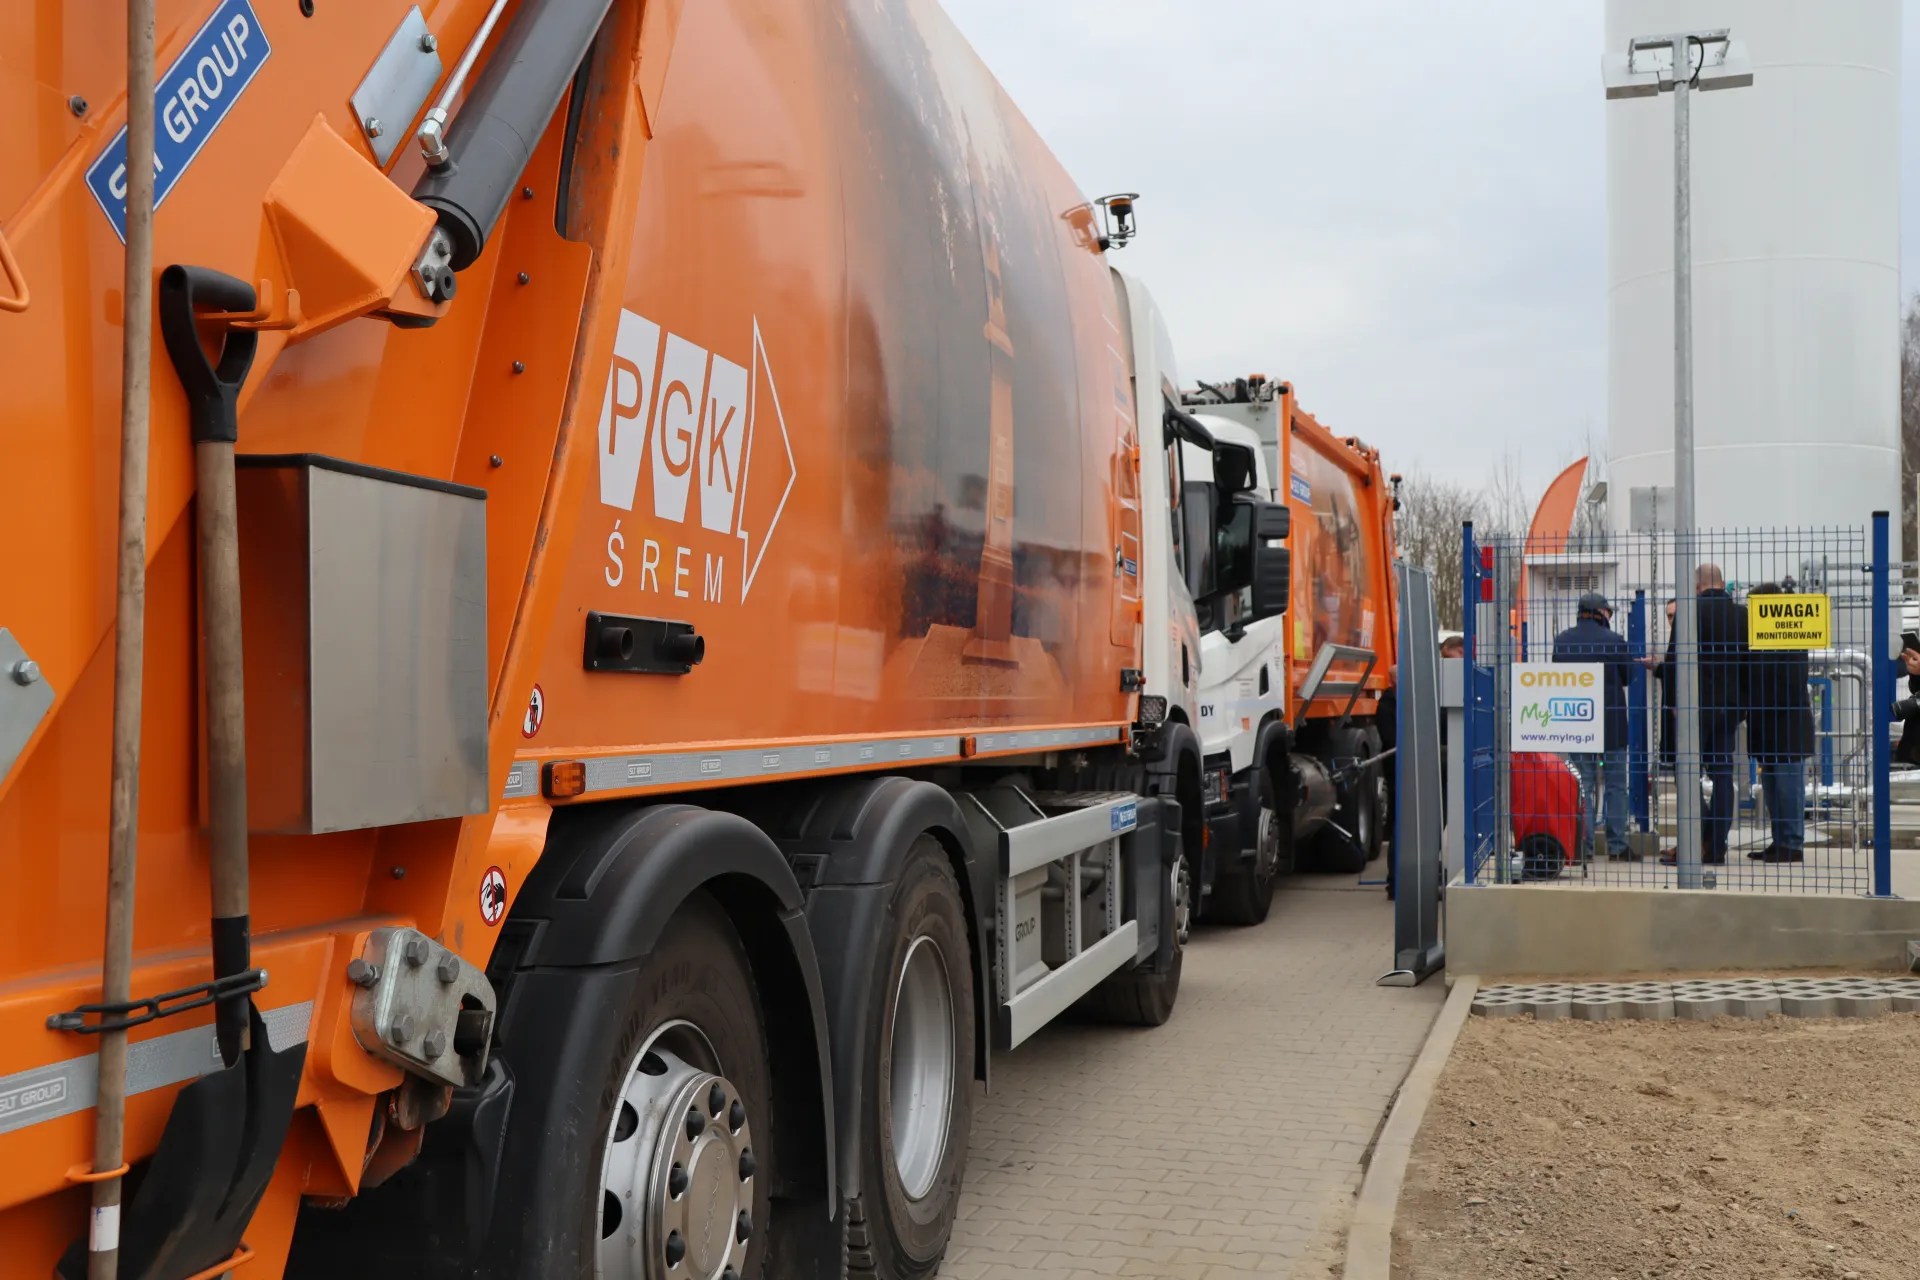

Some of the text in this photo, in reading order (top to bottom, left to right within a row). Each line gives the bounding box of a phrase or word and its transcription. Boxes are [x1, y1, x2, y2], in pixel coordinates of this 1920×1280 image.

[163, 14, 249, 143] GROUP
[608, 354, 736, 494] PGK
[605, 520, 723, 603] ŚREM
[1759, 604, 1820, 618] UWAGA!
[1775, 621, 1803, 629] OBIEKT
[1756, 632, 1822, 640] MONITOROWANY
[1520, 672, 1595, 687] omne
[1521, 733, 1595, 744] www.mylng.pl
[21, 1083, 62, 1105] GROUP
